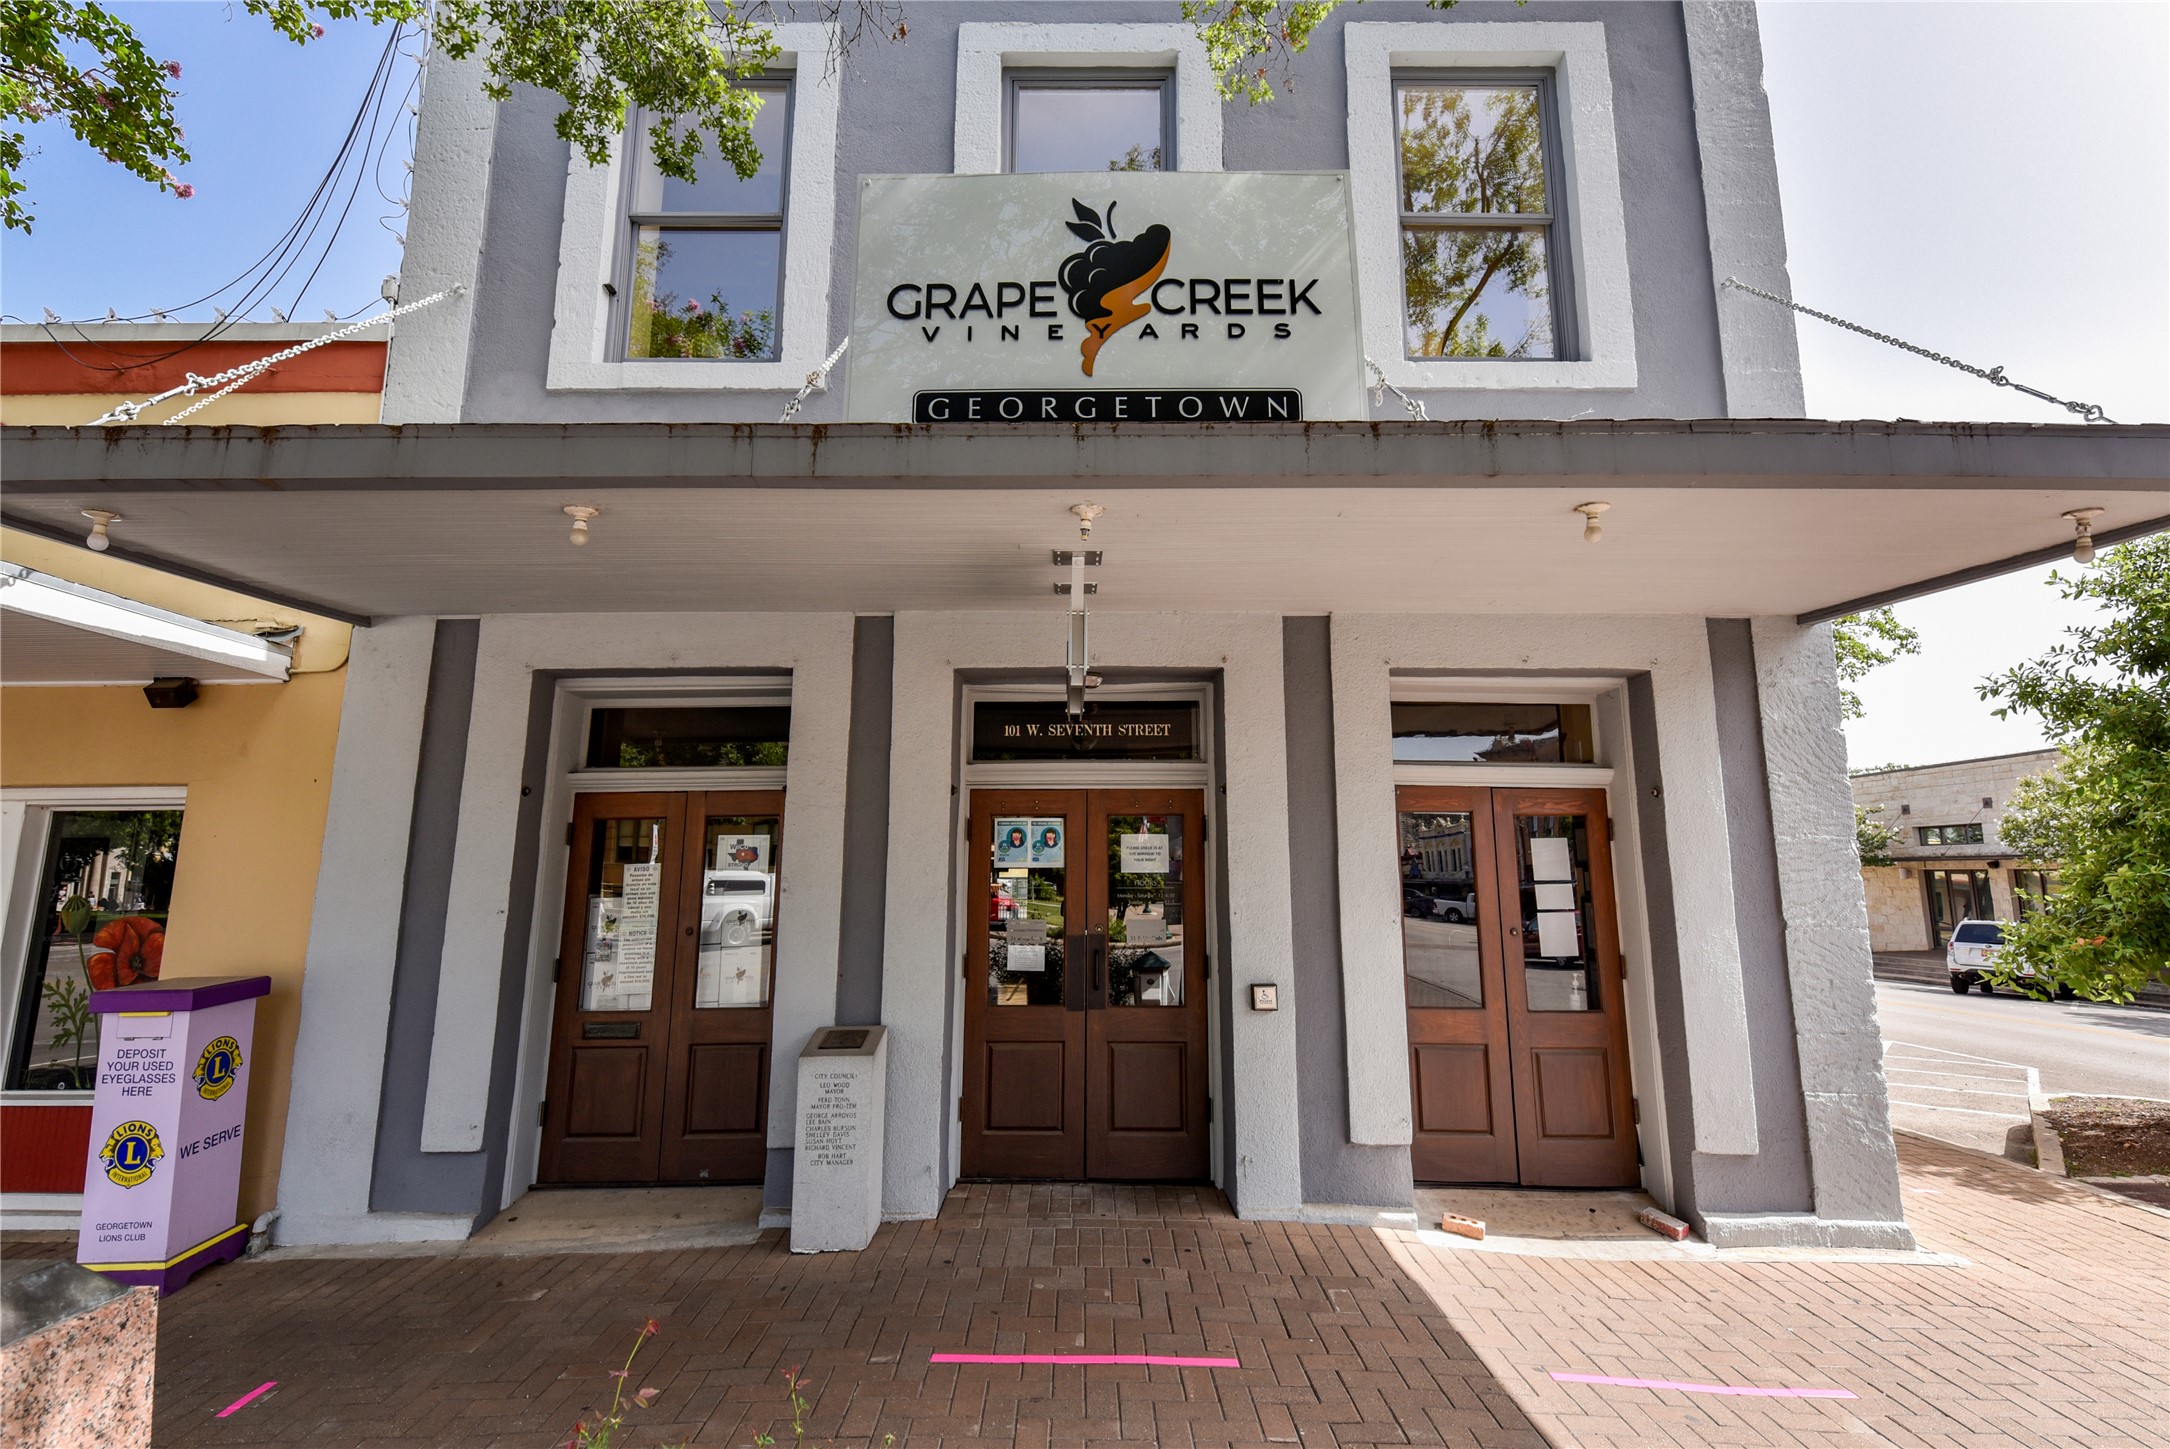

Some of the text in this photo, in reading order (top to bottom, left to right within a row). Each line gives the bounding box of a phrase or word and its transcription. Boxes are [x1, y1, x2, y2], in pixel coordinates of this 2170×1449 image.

[887, 277, 1322, 320] GRAPE CREEK
[922, 322, 1292, 342] VINEYARDS
[927, 395, 1290, 421] GEORGETOWN
[1003, 723, 1172, 737] 101 W. SEVENTH STREET
[116, 1048, 166, 1058] DEPOSIT
[206, 1039, 236, 1055] LIONS
[106, 1061, 174, 1072] YOUR USED
[212, 1056, 226, 1079] L
[101, 1073, 176, 1084] EYEGLASSES
[122, 1086, 153, 1096] HERE
[203, 1080, 231, 1097] INTERNATIONAL
[116, 1123, 154, 1138] LIONS
[180, 1124, 242, 1159] WE SERVE
[124, 1142, 140, 1165] L
[112, 1170, 148, 1183] INTERNATIONAL
[96, 1221, 152, 1231] GEORGETOWN
[98, 1233, 146, 1242] LIONS CLUB
